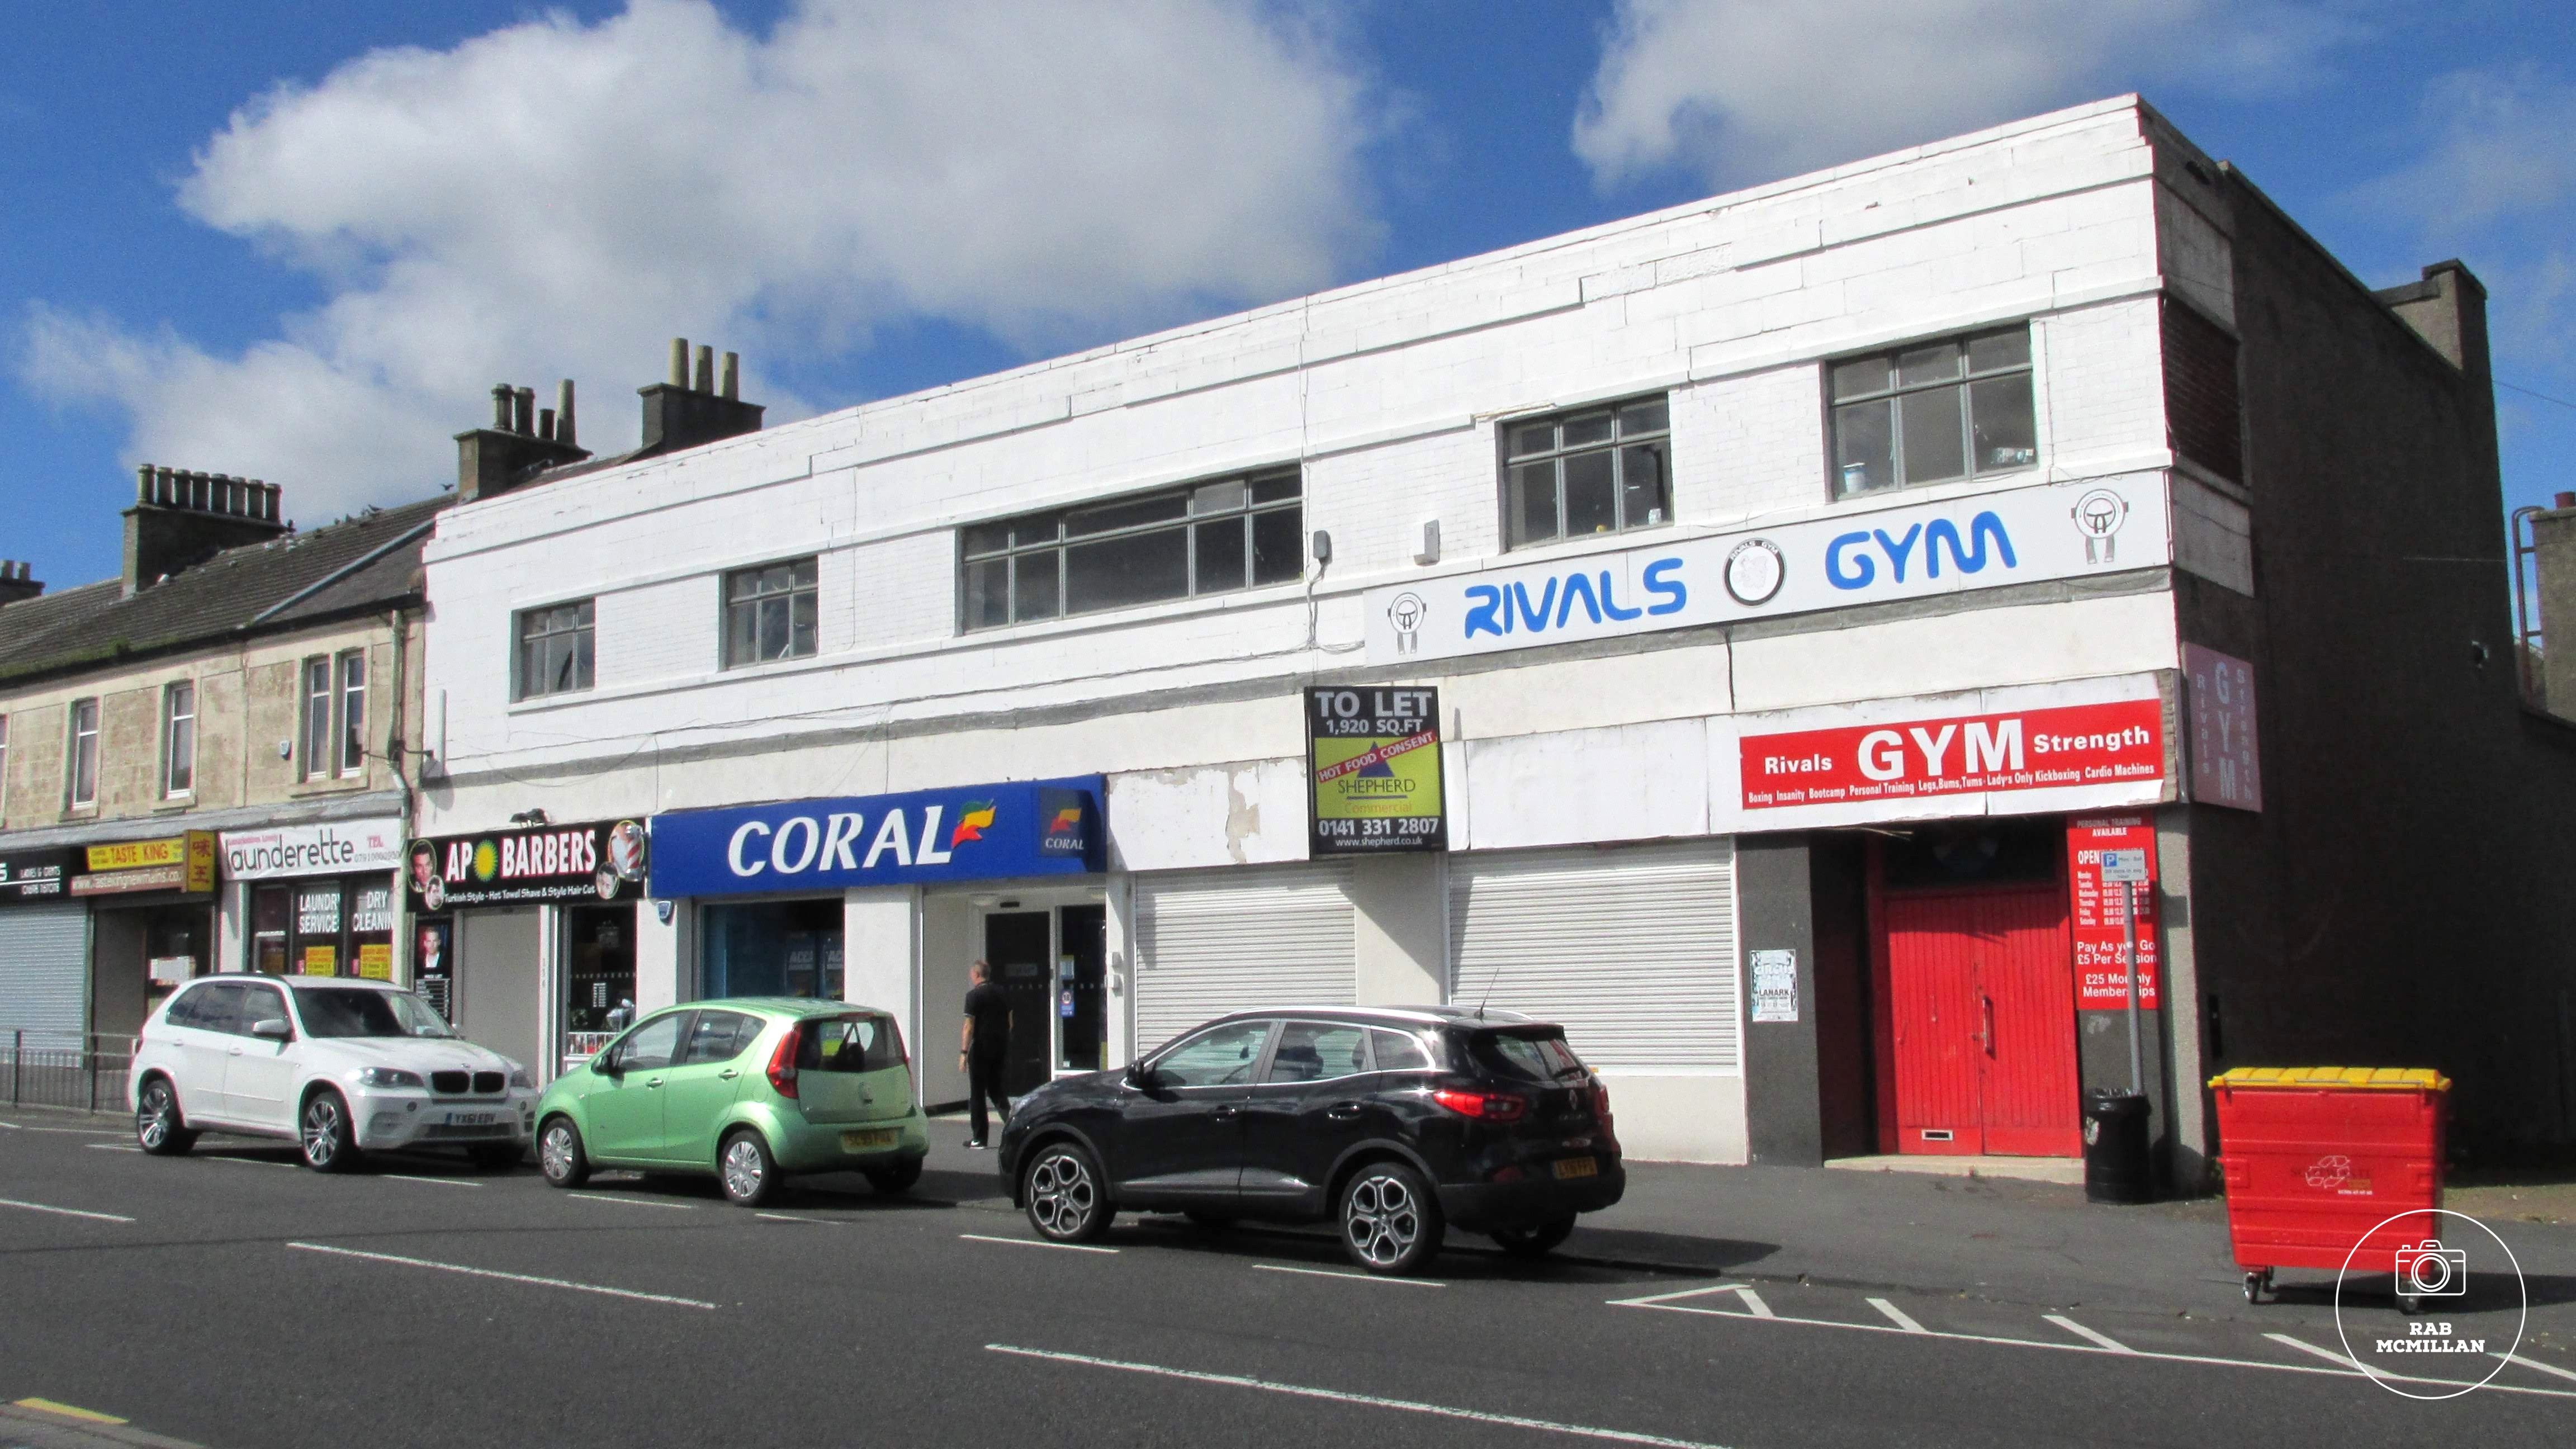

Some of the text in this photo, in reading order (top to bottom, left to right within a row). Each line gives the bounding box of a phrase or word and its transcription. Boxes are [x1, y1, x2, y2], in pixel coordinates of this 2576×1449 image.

[1761, 541, 1778, 555] GYM
[1465, 511, 2017, 638] RIVALS GYM
[1315, 691, 1432, 717] TO LET
[1327, 719, 1423, 735] 1,920 SQ.FT
[2215, 662, 2236, 800] GYM
[1319, 731, 1433, 782] HOT FOOD CONSENT
[1764, 719, 2150, 780] Rivals GYM Strength
[1338, 779, 1415, 793] SHEPHERD
[1749, 792, 1772, 804] Boxing
[1777, 789, 1805, 802] Insanity
[1809, 788, 1845, 800] Bootcamp
[1850, 784, 1881, 795] Personal
[1883, 782, 1914, 794] Training
[1987, 775, 2012, 788] Lady's
[2015, 773, 2033, 785] Only
[2035, 769, 2080, 782] Kickboxing
[2085, 765, 2112, 778] Cardio
[2115, 763, 2154, 776] Machines
[1345, 801, 1412, 813] Commercial
[1319, 818, 1438, 836] 0141 331 2807
[2077, 819, 2109, 828] PERSONAL
[2092, 827, 2127, 836] AVAILABLE
[727, 805, 953, 877] CORAL
[1045, 838, 1085, 850] CORAL
[1336, 836, 1422, 847] www.shepherd.co.uk
[110, 846, 137, 864] TASTE
[143, 843, 168, 860] KING
[225, 828, 354, 873] launderette
[445, 830, 596, 882] AP BARBERS
[2077, 850, 2100, 864] OPEN
[367, 890, 387, 909] DRY
[467, 892, 485, 903] Style
[489, 891, 501, 900] Hot
[503, 889, 520, 899] Towel
[521, 888, 541, 898] Shave
[542, 886, 547, 897] &
[548, 886, 567, 898] Style
[568, 886, 582, 895] Hair
[583, 884, 596, 894] Cut
[352, 912, 393, 932] CLEANIN
[2077, 941, 2096, 954] Pay
[2100, 940, 2114, 951] As
[2140, 940, 2156, 950] Go
[2077, 953, 2157, 965] £5 Per Sesion
[2086, 973, 2105, 984] £25
[2083, 986, 2156, 999] Memberips
